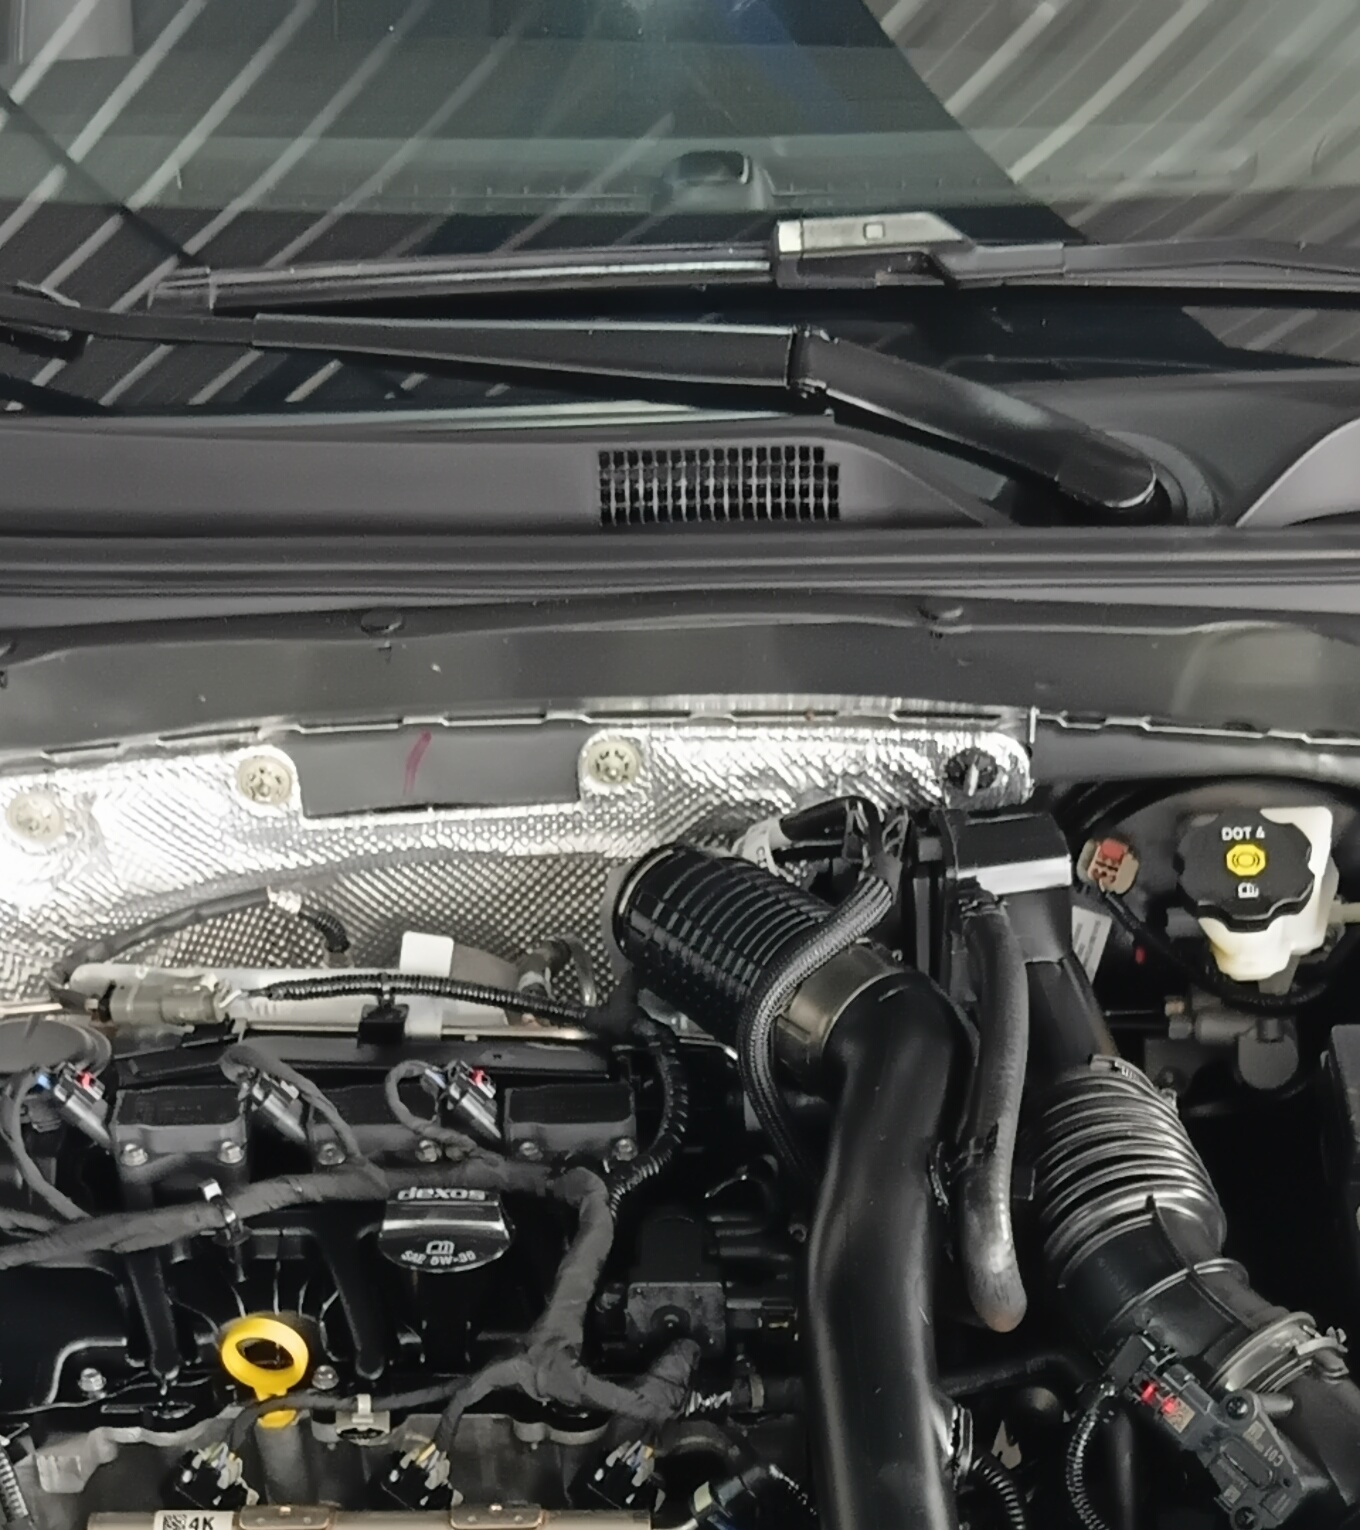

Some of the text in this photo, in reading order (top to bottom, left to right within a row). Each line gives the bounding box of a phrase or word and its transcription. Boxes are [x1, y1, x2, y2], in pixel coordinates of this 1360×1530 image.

[1221, 826, 1266, 841] DOT 4
[397, 1186, 486, 1201] dexos
